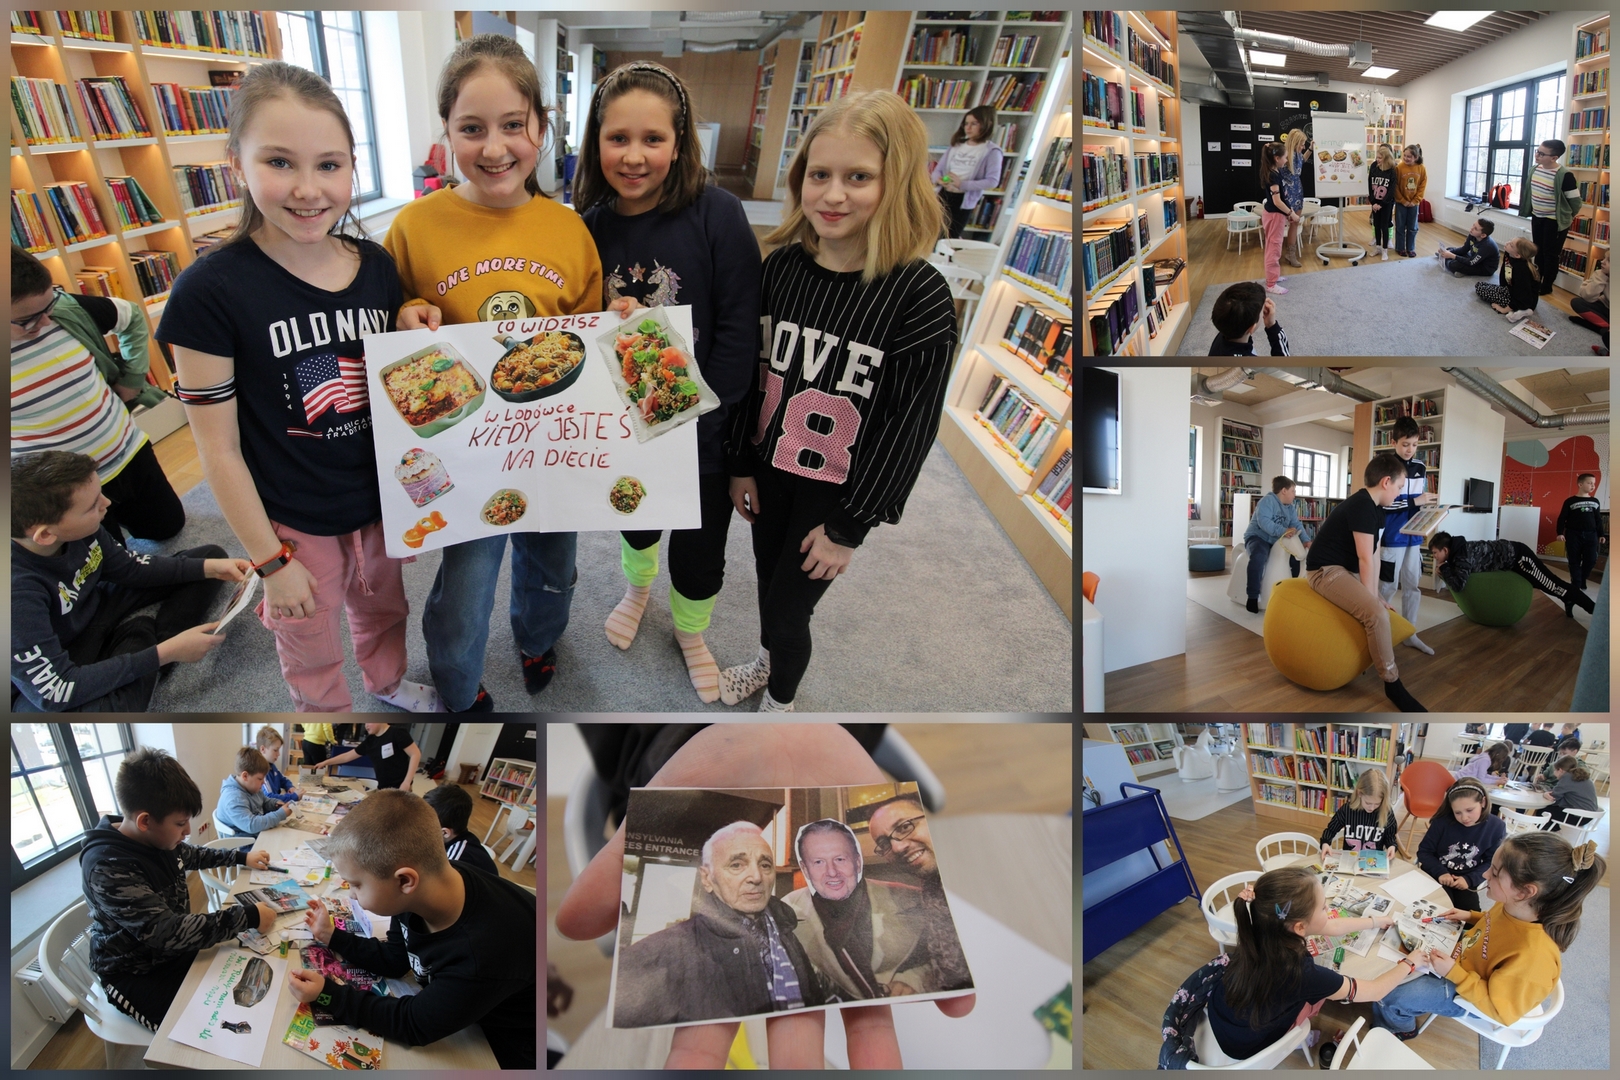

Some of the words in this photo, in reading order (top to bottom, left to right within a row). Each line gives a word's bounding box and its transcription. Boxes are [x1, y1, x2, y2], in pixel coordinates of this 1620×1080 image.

[436, 267, 470, 296] ONE
[475, 257, 526, 276] MORE
[529, 260, 565, 289] TIME
[269, 311, 331, 358] OLD
[335, 308, 389, 342] NAVY
[497, 319, 516, 334] CO
[501, 449, 533, 473] NA
[13, 644, 75, 703] INHALE
[1345, 825, 1384, 841] LOVE
[645, 843, 699, 856] ENTRANCE
